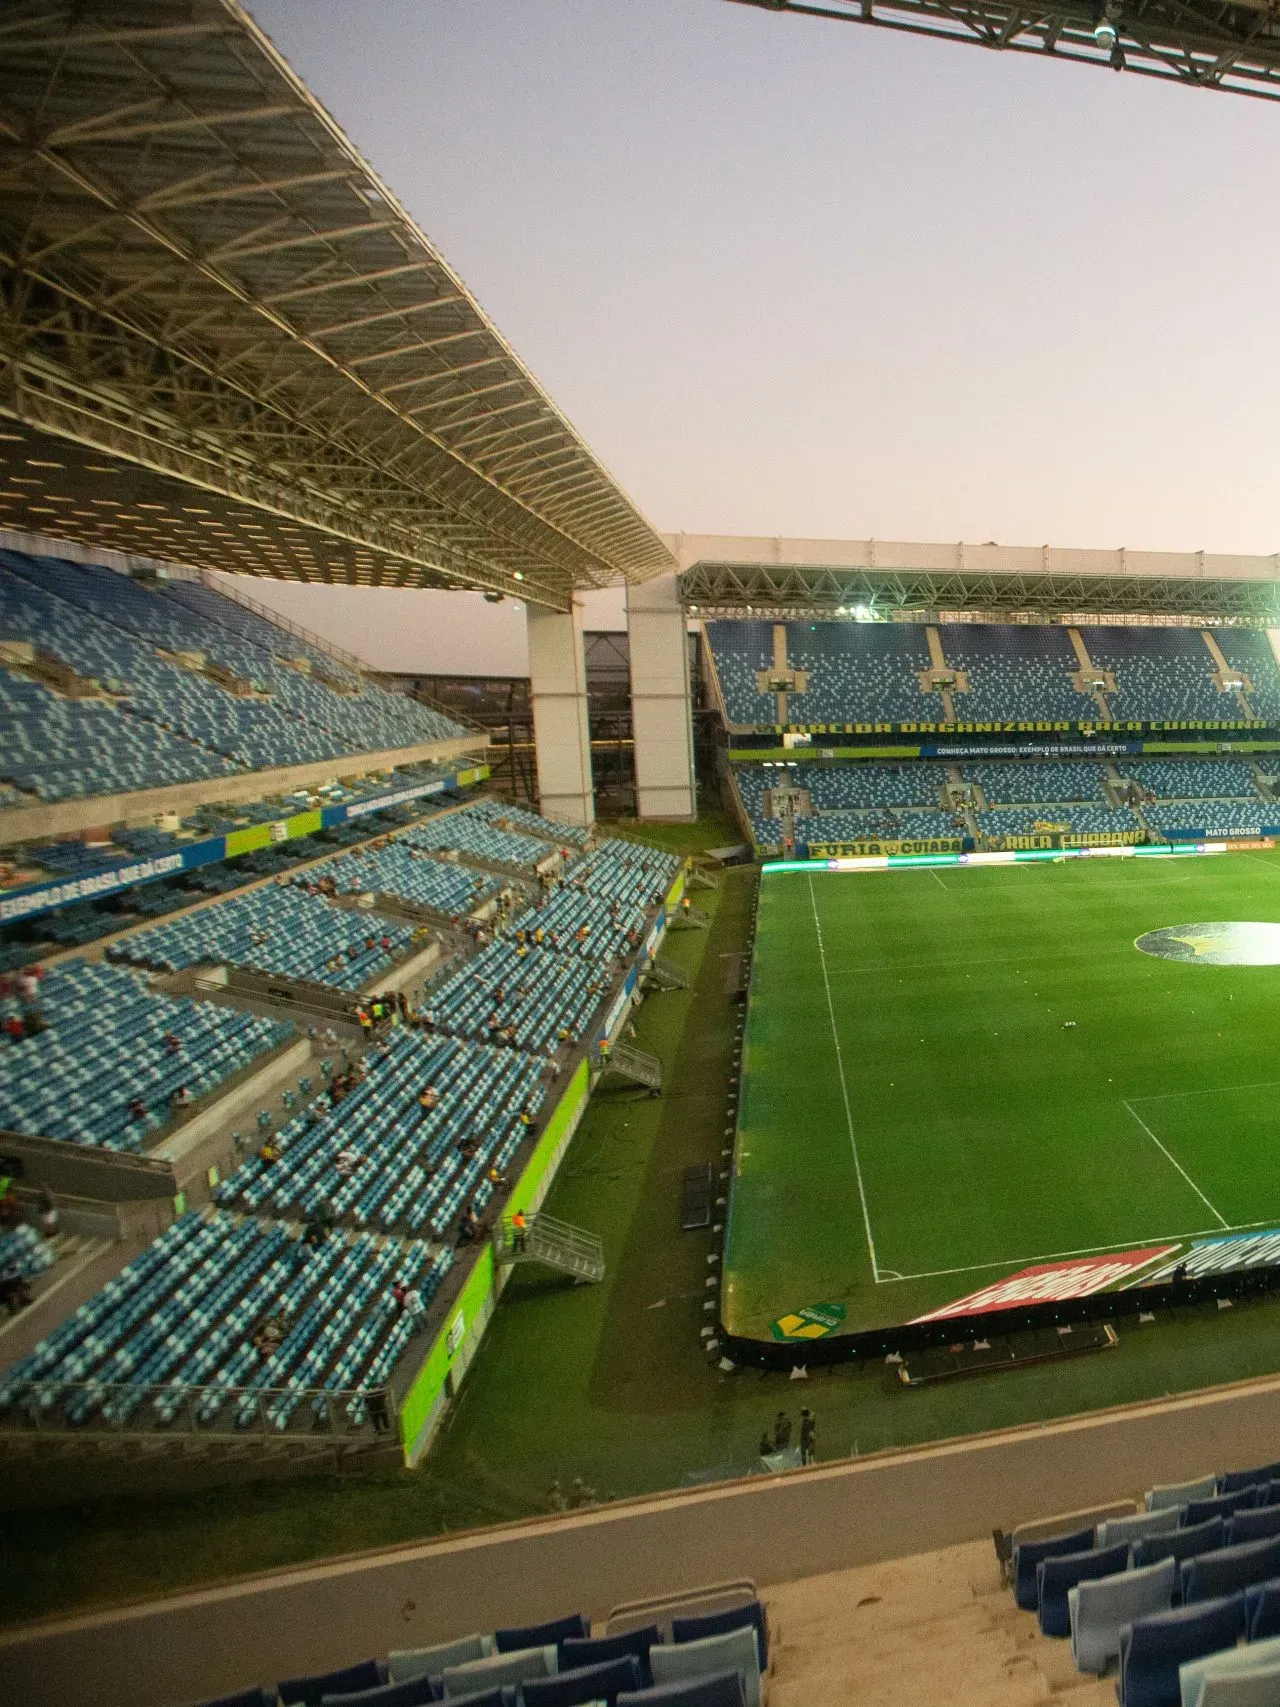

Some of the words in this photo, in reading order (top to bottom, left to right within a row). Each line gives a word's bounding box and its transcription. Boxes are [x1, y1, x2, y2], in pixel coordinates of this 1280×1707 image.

[775, 722, 892, 734] TORCIDA
[900, 721, 1070, 733] ORGANIZADA
[1150, 720, 1267, 731] CUIABANA
[937, 747, 969, 756] CONHEÇA
[1205, 828, 1228, 837] MATO
[1229, 827, 1261, 836] GROSSO
[1060, 831, 1146, 848] CUIABANA
